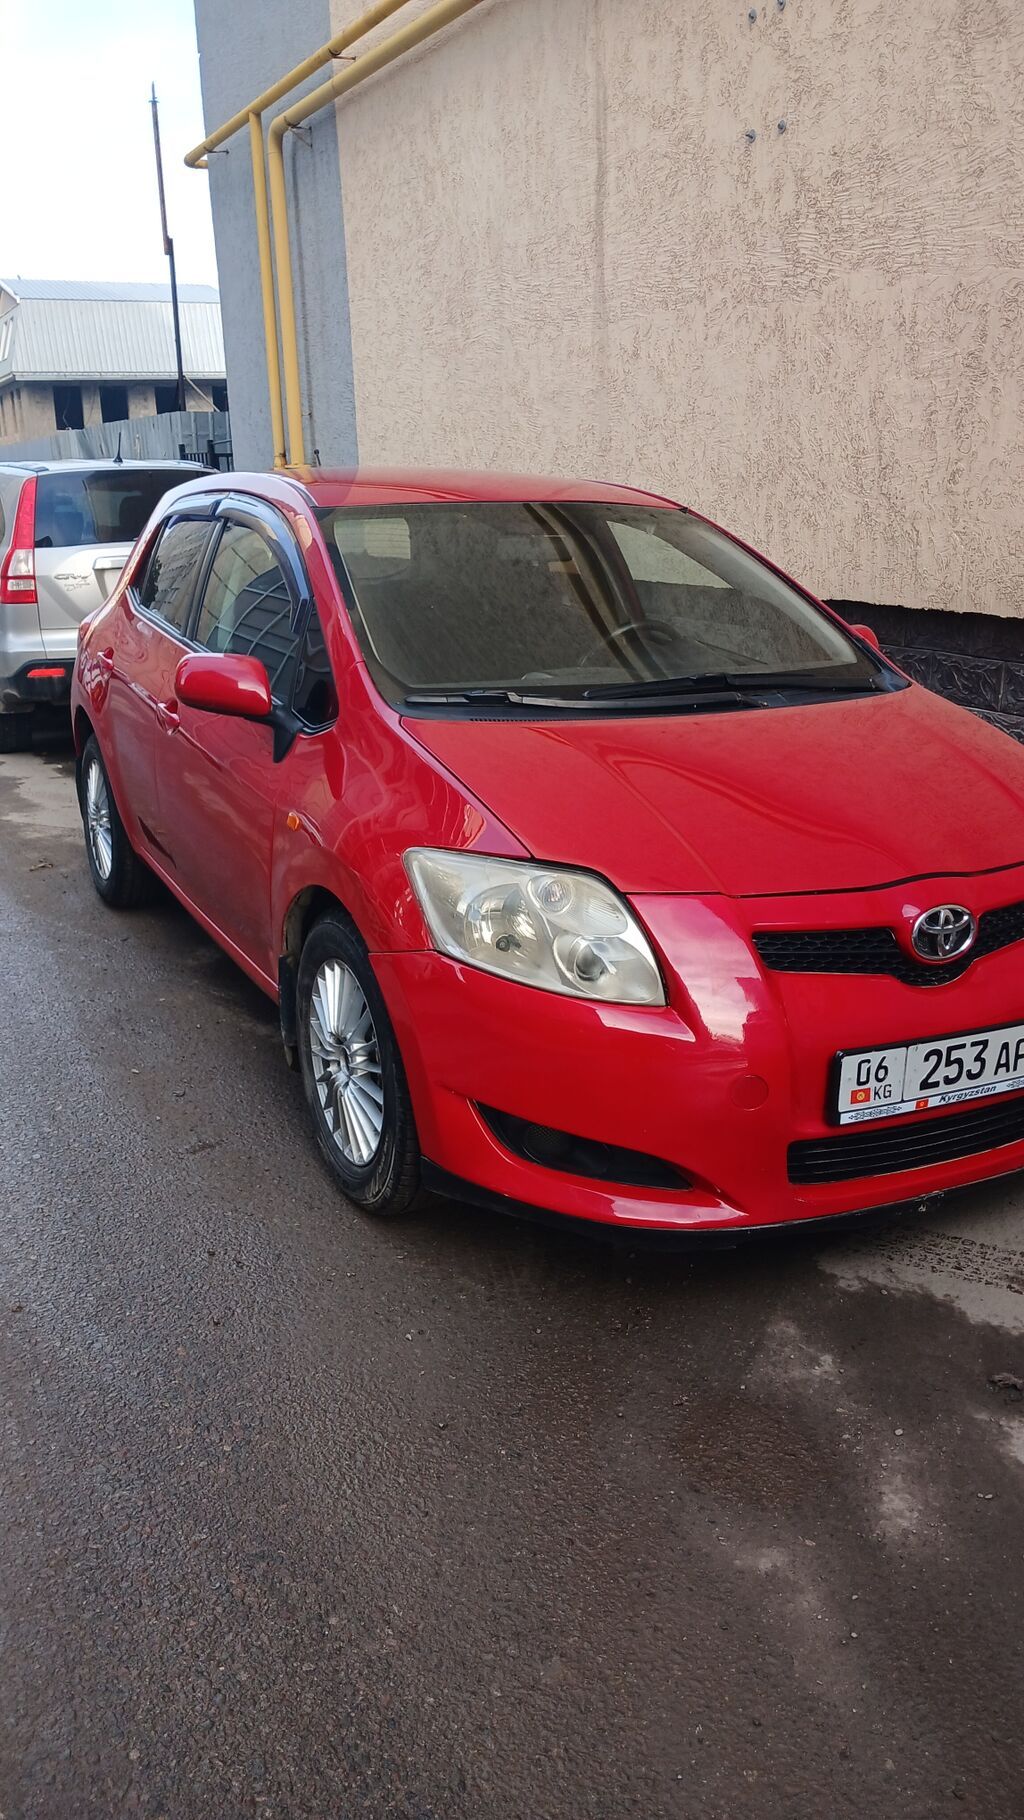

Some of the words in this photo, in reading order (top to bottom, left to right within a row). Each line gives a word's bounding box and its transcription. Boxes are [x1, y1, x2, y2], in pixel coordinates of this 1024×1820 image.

[856, 1055, 889, 1086] 06
[919, 1039, 989, 1091] 253
[872, 1083, 892, 1101] KG
[938, 1085, 997, 1103] Kyrgyzstan
